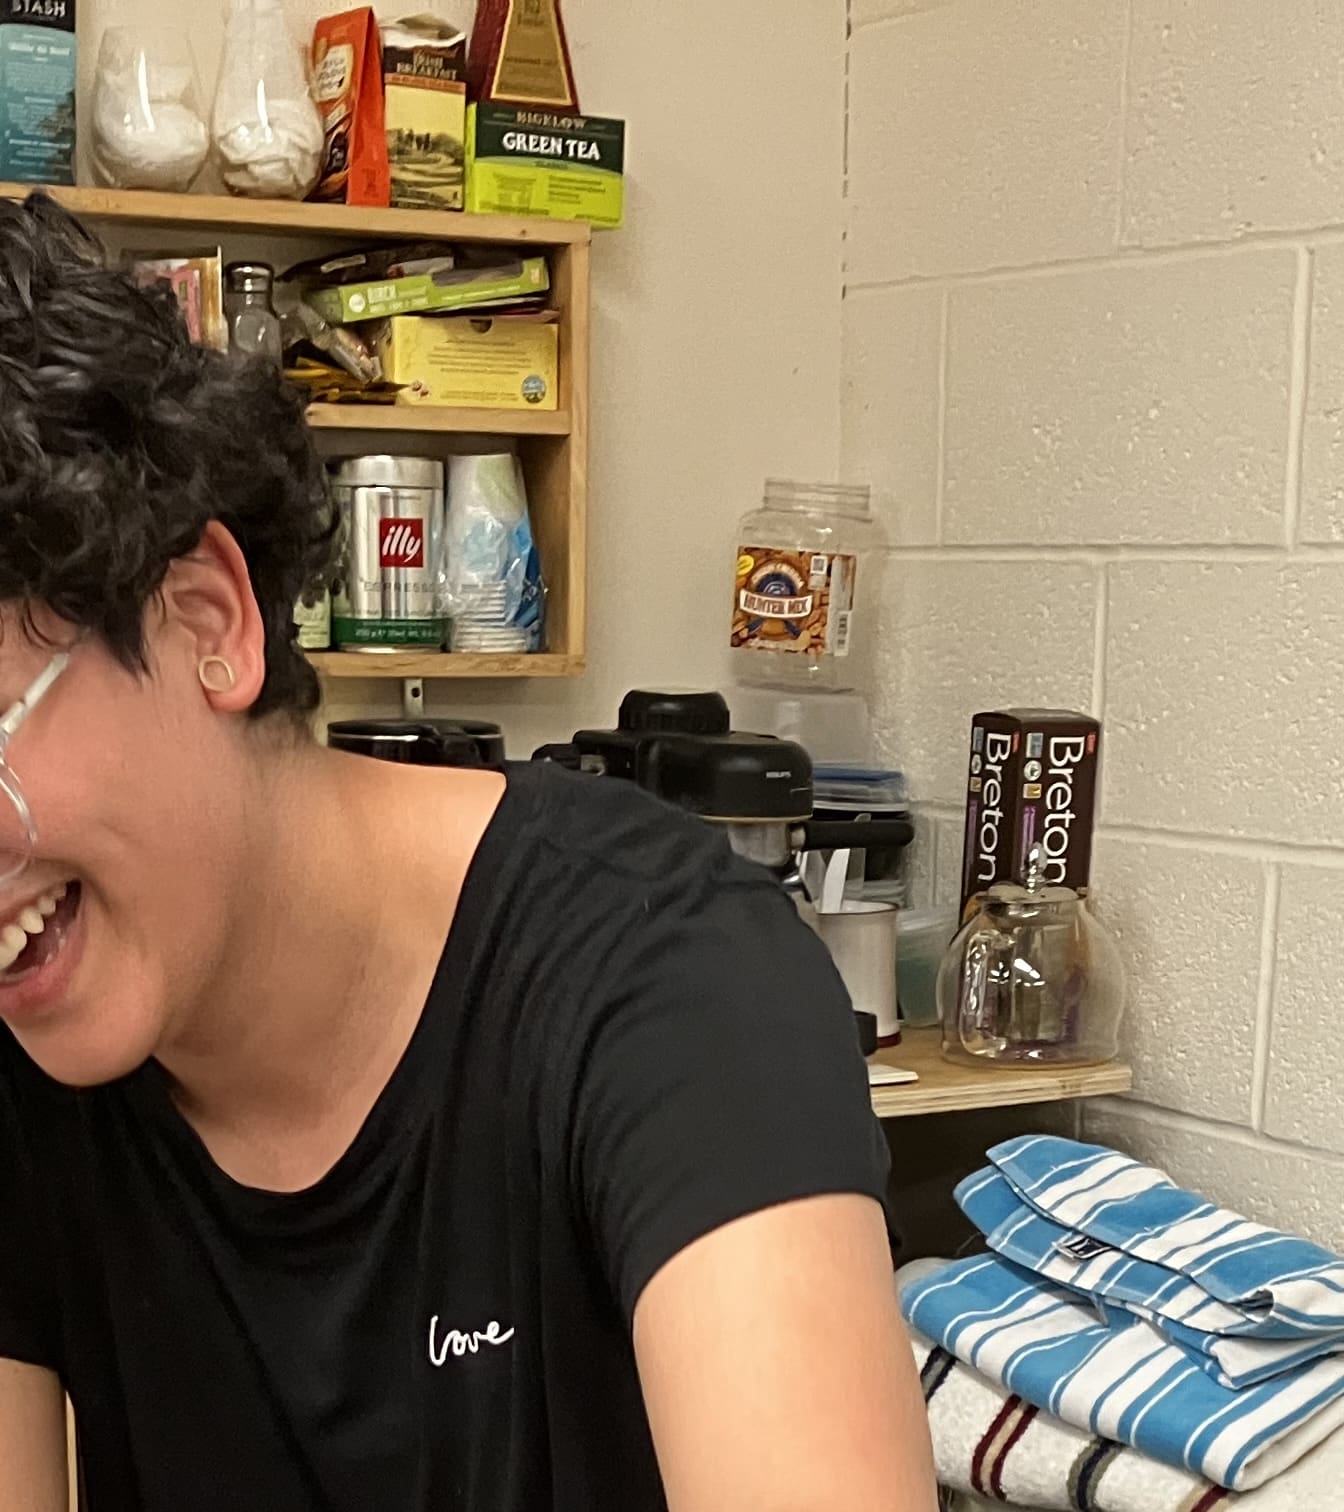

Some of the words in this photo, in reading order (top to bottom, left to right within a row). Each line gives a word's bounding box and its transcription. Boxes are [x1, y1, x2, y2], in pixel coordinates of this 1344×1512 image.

[516, 111, 587, 130] BIGELOW
[502, 132, 563, 156] GREEN
[565, 139, 601, 161] TEA
[382, 524, 421, 563] illy
[977, 732, 1012, 882] Breton
[1042, 736, 1086, 884] Breton
